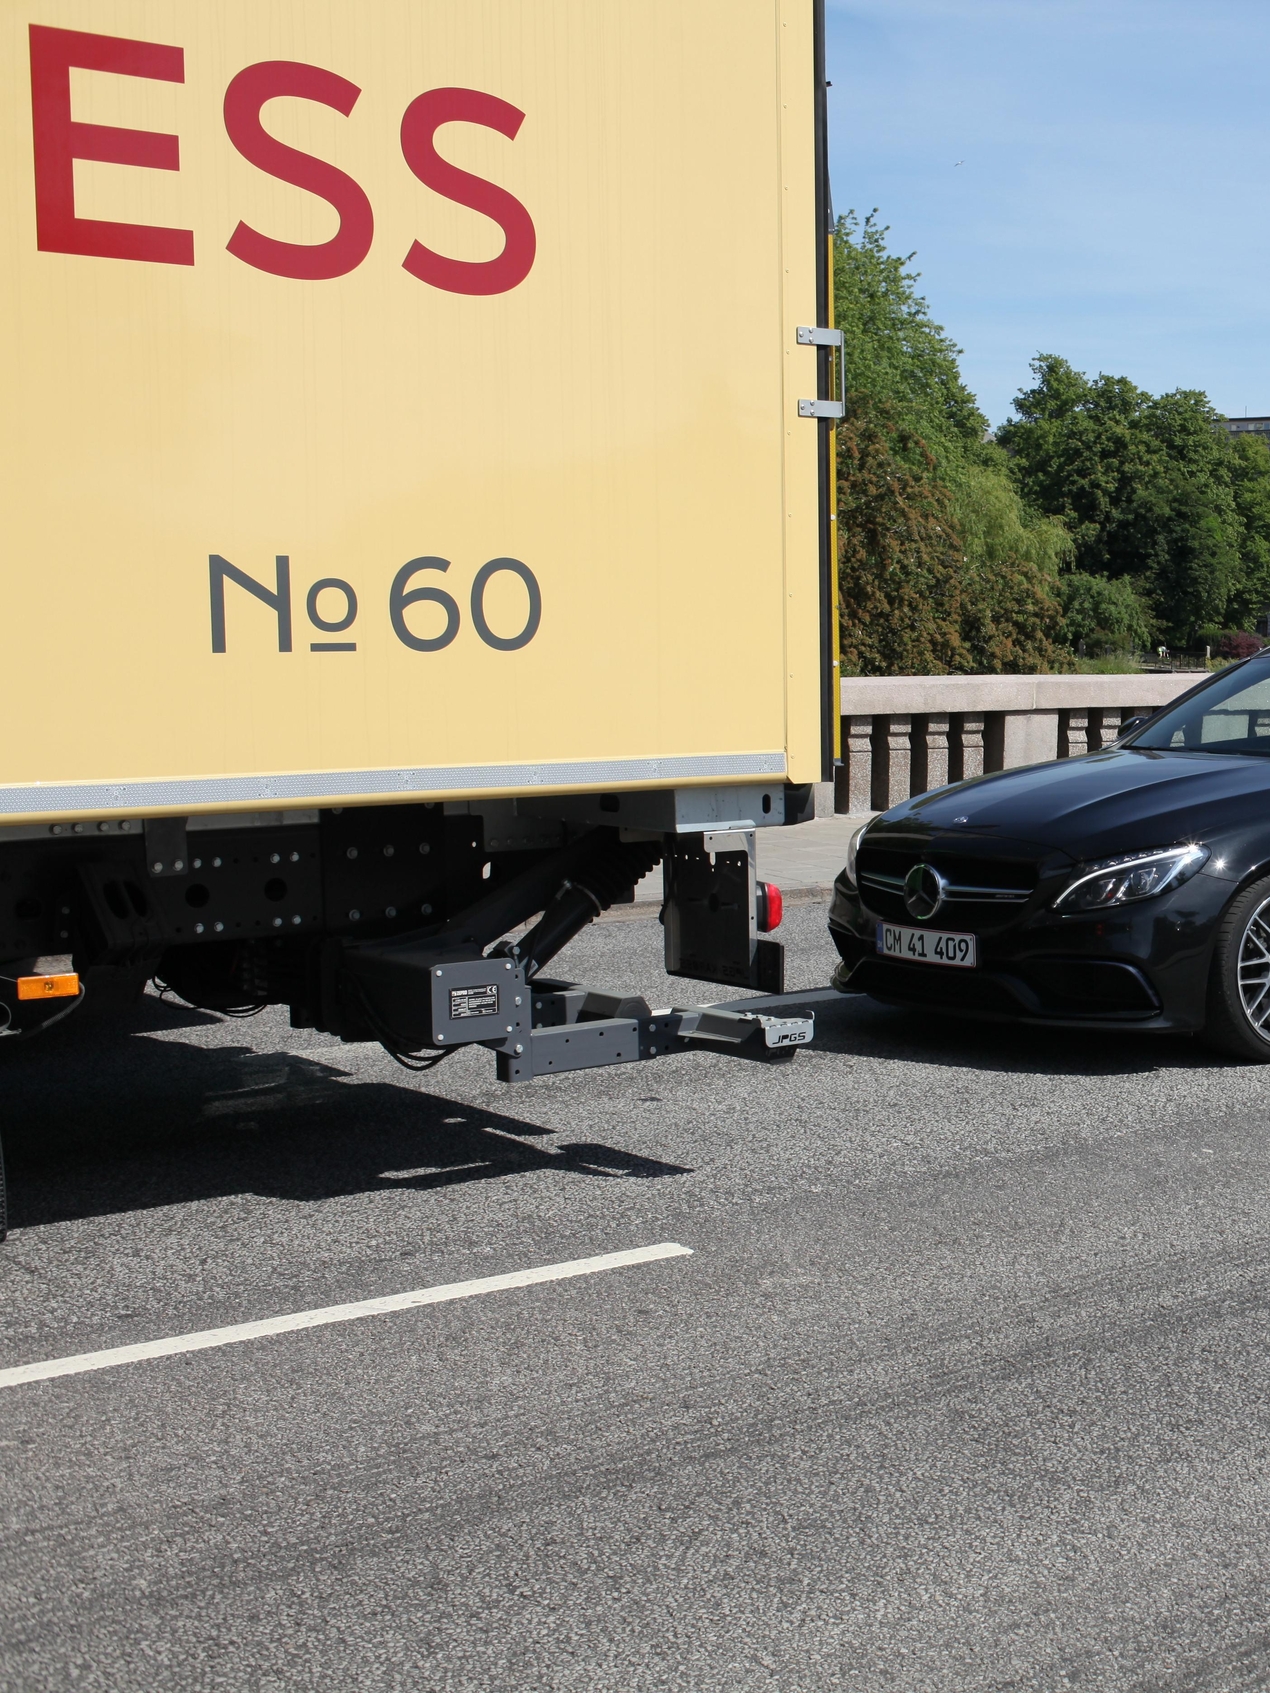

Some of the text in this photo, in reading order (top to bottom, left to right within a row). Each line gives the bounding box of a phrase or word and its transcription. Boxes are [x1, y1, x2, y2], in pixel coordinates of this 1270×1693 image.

[28, 23, 537, 296] ESS
[389, 556, 542, 653] 60
[885, 928, 969, 962] CM 41 409
[772, 1031, 806, 1045] JPGS
